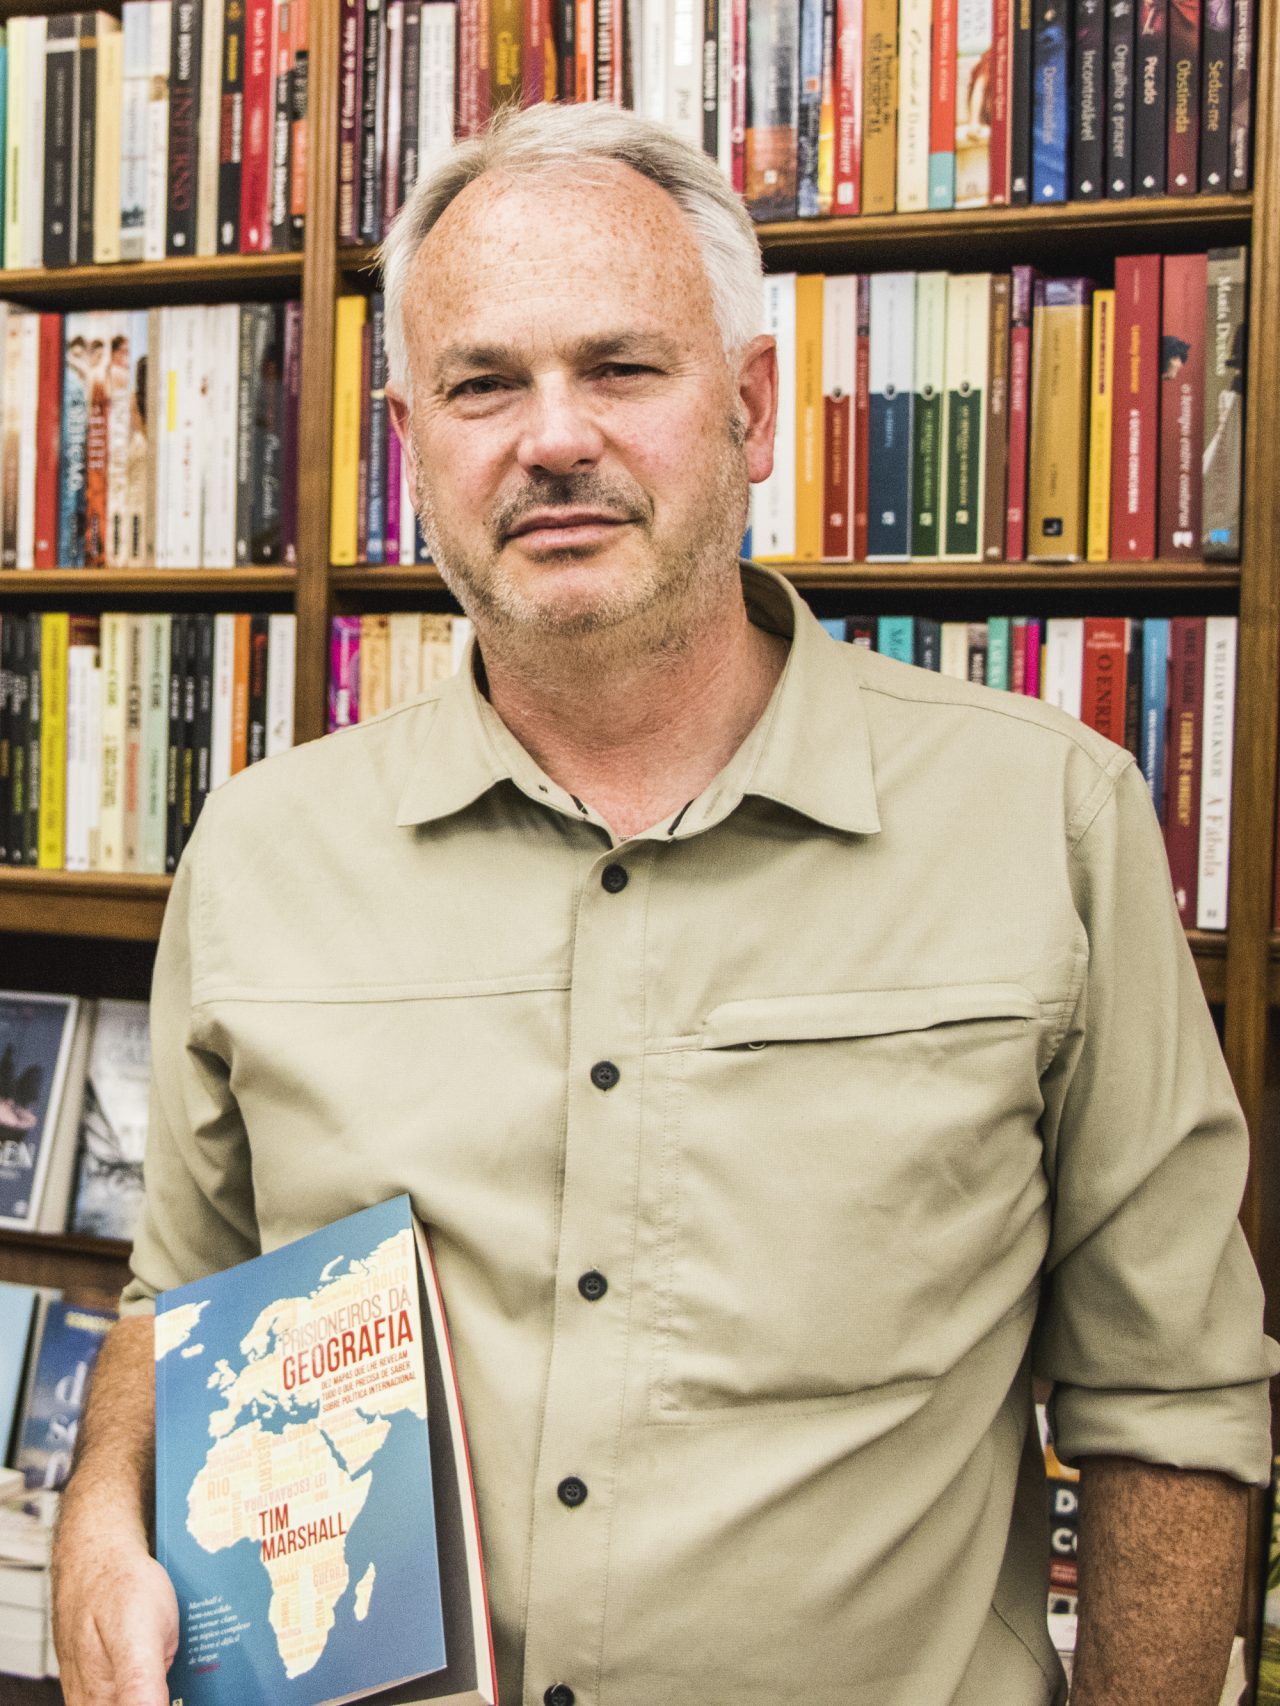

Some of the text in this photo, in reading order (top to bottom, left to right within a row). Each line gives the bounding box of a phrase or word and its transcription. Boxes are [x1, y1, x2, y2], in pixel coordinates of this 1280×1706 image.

[178, 3, 192, 80] DAN BROWN
[1080, 50, 1097, 141] Incontrolável
[1111, 44, 1130, 99] Orgulho
[1142, 56, 1158, 105] Pecado
[1174, 59, 1192, 134] Obstinada
[1206, 59, 1224, 132] Seduz-me
[172, 86, 194, 211] INFERNO
[1111, 115, 1127, 158] prazer
[1177, 396, 1195, 436] tempo
[1178, 437, 1193, 471] entre
[1178, 473, 1192, 527] costuras
[1209, 639, 1229, 779] WILLIAM FAULKNER
[1202, 792, 1224, 880] A Fábula
[282, 1284, 412, 1357] PRISIONEIROS DA
[282, 1309, 414, 1391] GEOGRAFIA
[321, 1350, 409, 1391] DEZ MAPAS QUE LHE REVELAM
[322, 1388, 337, 1401] TUDO
[343, 1381, 355, 1394] QUE
[355, 1371, 381, 1390] PRECISA
[390, 1360, 411, 1376] SABER
[322, 1370, 417, 1412] SOBRE POLÍTICA INTERNACIONAL
[207, 1476, 230, 1502] RIO
[258, 1502, 290, 1537] TIM
[261, 1511, 347, 1563] MARSHALL
[189, 1595, 218, 1610] Marshall
